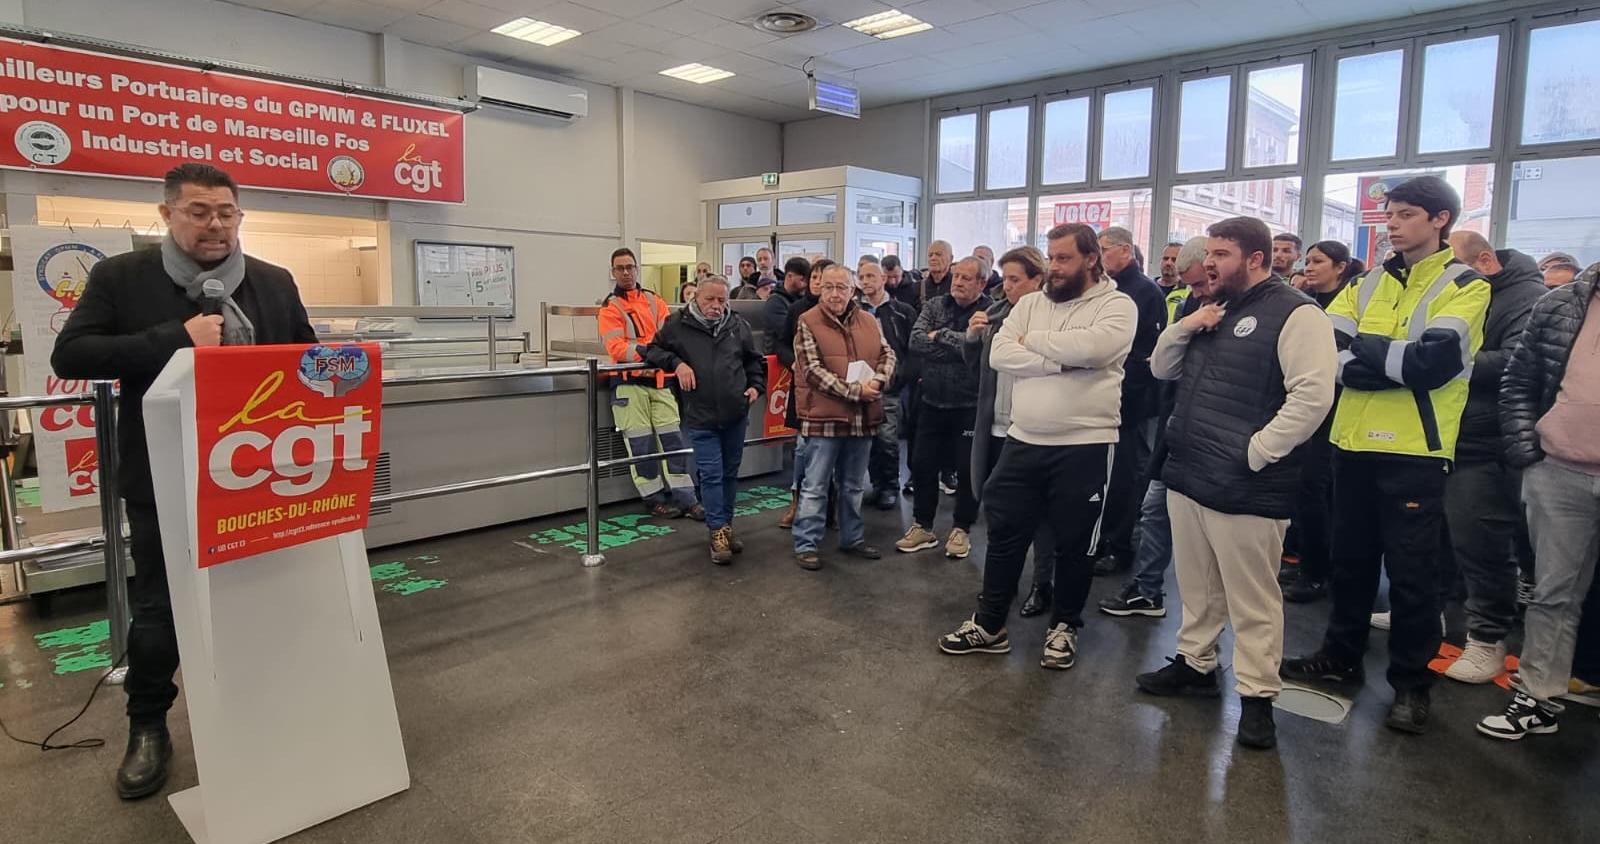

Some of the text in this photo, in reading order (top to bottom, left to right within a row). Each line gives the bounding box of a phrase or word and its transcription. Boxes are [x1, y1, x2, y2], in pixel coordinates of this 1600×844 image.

[0, 57, 449, 138] illeurs Portuaires du GPMM & FLUXEL
[0, 93, 370, 152] pour un Port de Marseille Fos
[82, 130, 212, 160] Industriel
[219, 147, 244, 164] et
[249, 148, 318, 171] Social
[396, 143, 432, 163] la
[394, 160, 442, 193] cgt
[1055, 203, 1110, 223] votez
[475, 280, 484, 293] 5
[315, 356, 356, 373] FSM
[219, 370, 372, 432] la
[208, 405, 372, 497] cgt
[217, 493, 357, 534] BOUCHES-DU-RHÔNE
